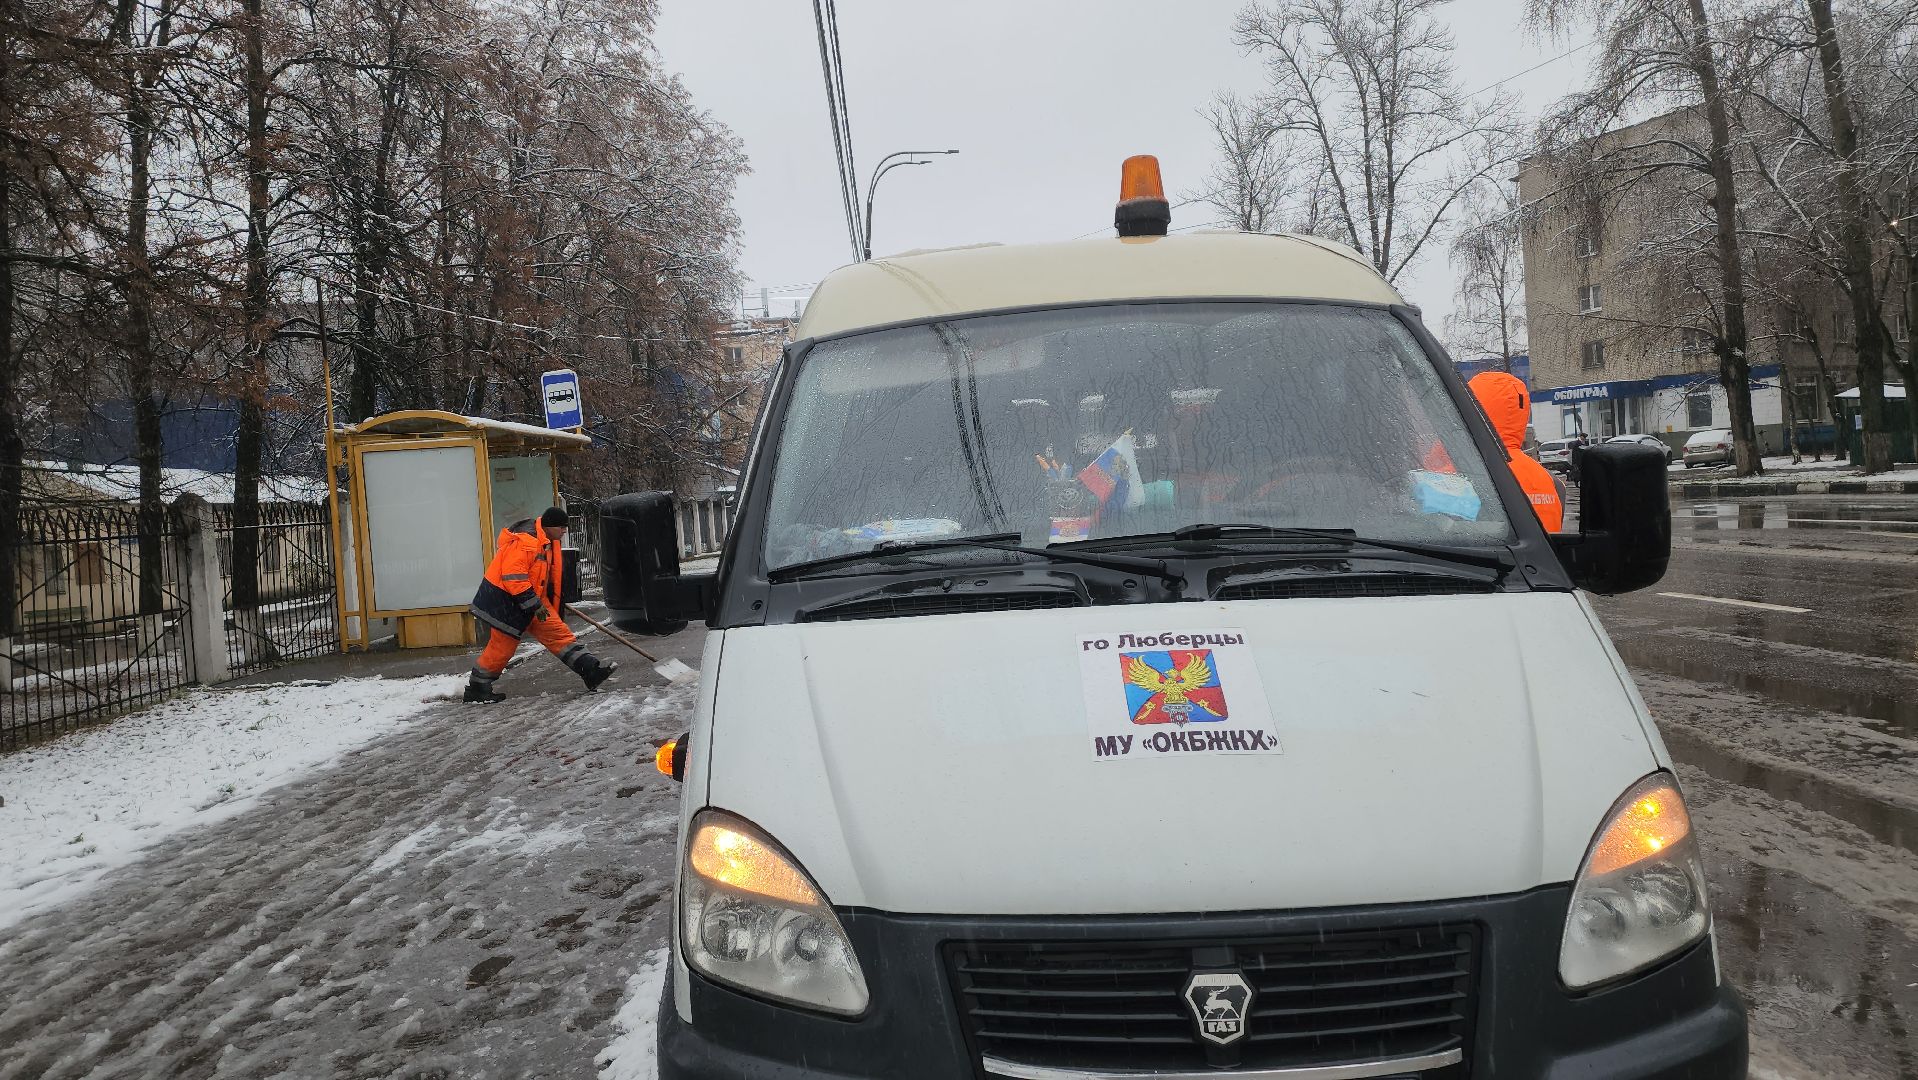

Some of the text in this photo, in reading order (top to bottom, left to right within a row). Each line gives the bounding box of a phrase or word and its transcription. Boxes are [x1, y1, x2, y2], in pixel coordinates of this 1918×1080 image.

[1082, 632, 1244, 651] го Люберцы
[1095, 729, 1278, 756] МУ «ОКБЖКХ»
[1207, 1021, 1237, 1032] ГАЗ
